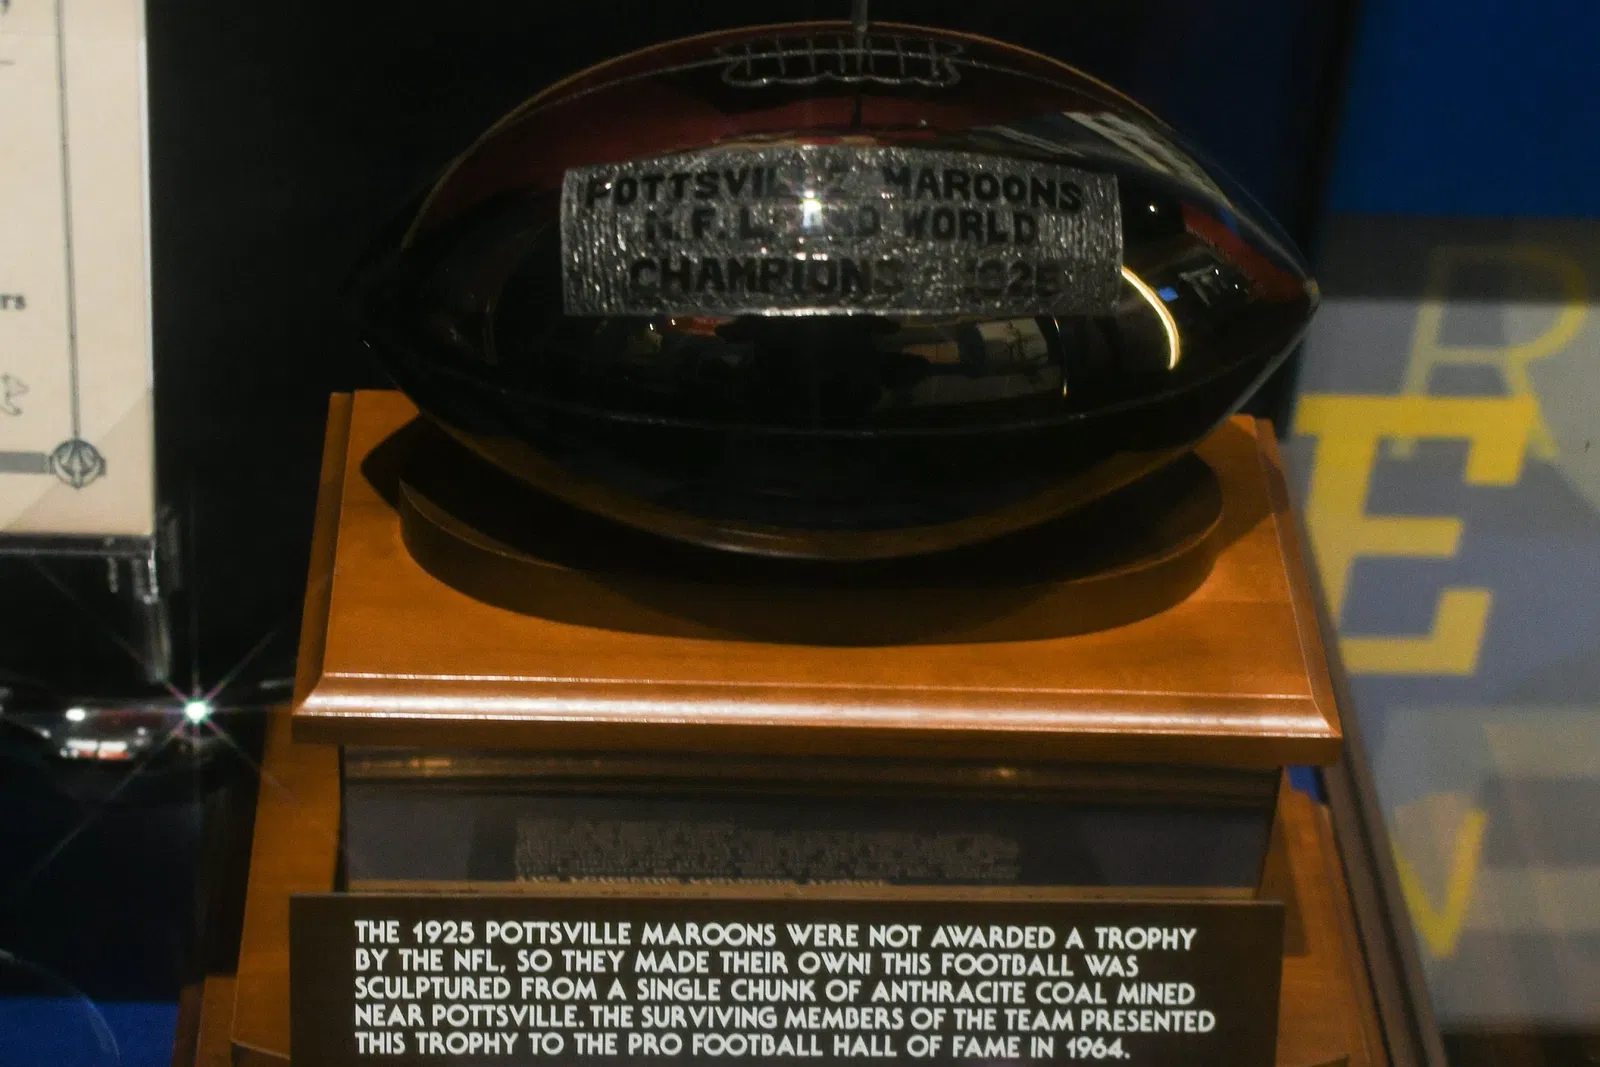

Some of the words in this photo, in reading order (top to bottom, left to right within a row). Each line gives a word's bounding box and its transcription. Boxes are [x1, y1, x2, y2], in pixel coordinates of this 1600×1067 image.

[883, 166, 1083, 213] MAROONS
[905, 205, 1038, 245] WORLD
[630, 257, 904, 294] CHAMPIONS
[355, 920, 399, 943] THE
[413, 920, 474, 944] 1925
[486, 921, 631, 945] POTTSVILLE
[641, 923, 776, 946] MAROONS
[787, 924, 859, 947] WERE
[870, 924, 921, 947] NOT
[931, 926, 1055, 948] AWARDED
[1065, 927, 1084, 949] A
[1095, 927, 1196, 950] TROPHY
[356, 948, 388, 971] BY
[399, 949, 443, 971] THE
[454, 949, 506, 973] NFL,
[517, 949, 552, 972] SO
[562, 950, 625, 972] THEY
[635, 950, 709, 973] MADE
[720, 951, 788, 973] THEIR
[798, 952, 871, 974] OWN!
[882, 953, 931, 975] THIS
[942, 953, 1074, 976] FOOTBALL
[1085, 955, 1138, 977] WAS
[355, 976, 510, 999] SCULPTURED
[522, 977, 597, 1000] FROM
[607, 978, 626, 1000] A
[637, 978, 721, 1001] SINGLE
[731, 979, 816, 1002] CHUNK
[825, 979, 861, 1002] OF
[871, 980, 1026, 1003] ANTHRACITE
[1036, 981, 1107, 1004] COAL
[1117, 983, 1195, 1005] MINED
[355, 1004, 424, 1026] NEAR
[433, 1004, 584, 1028] POTTSVILLE.
[590, 1005, 633, 1028] THE
[641, 1005, 777, 1029] SURVIVING
[784, 1007, 904, 1030] MEMBERS
[911, 1007, 946, 1030] OF
[953, 1008, 997, 1030] THE
[1004, 1009, 1074, 1031] TEAM
[1081, 1009, 1215, 1032] PRESENTED
[355, 1032, 405, 1054] THIS
[415, 1032, 518, 1055] TROPHY
[529, 1032, 564, 1055] TO
[574, 1033, 617, 1055] THE
[628, 1033, 682, 1055] PRO
[693, 1033, 823, 1056] FOOTBALL
[834, 1035, 897, 1057] HALL
[907, 1035, 942, 1057] OF
[953, 1036, 1020, 1058] FAME
[1031, 1036, 1053, 1058] IN
[1067, 1036, 1130, 1059] 1964.
